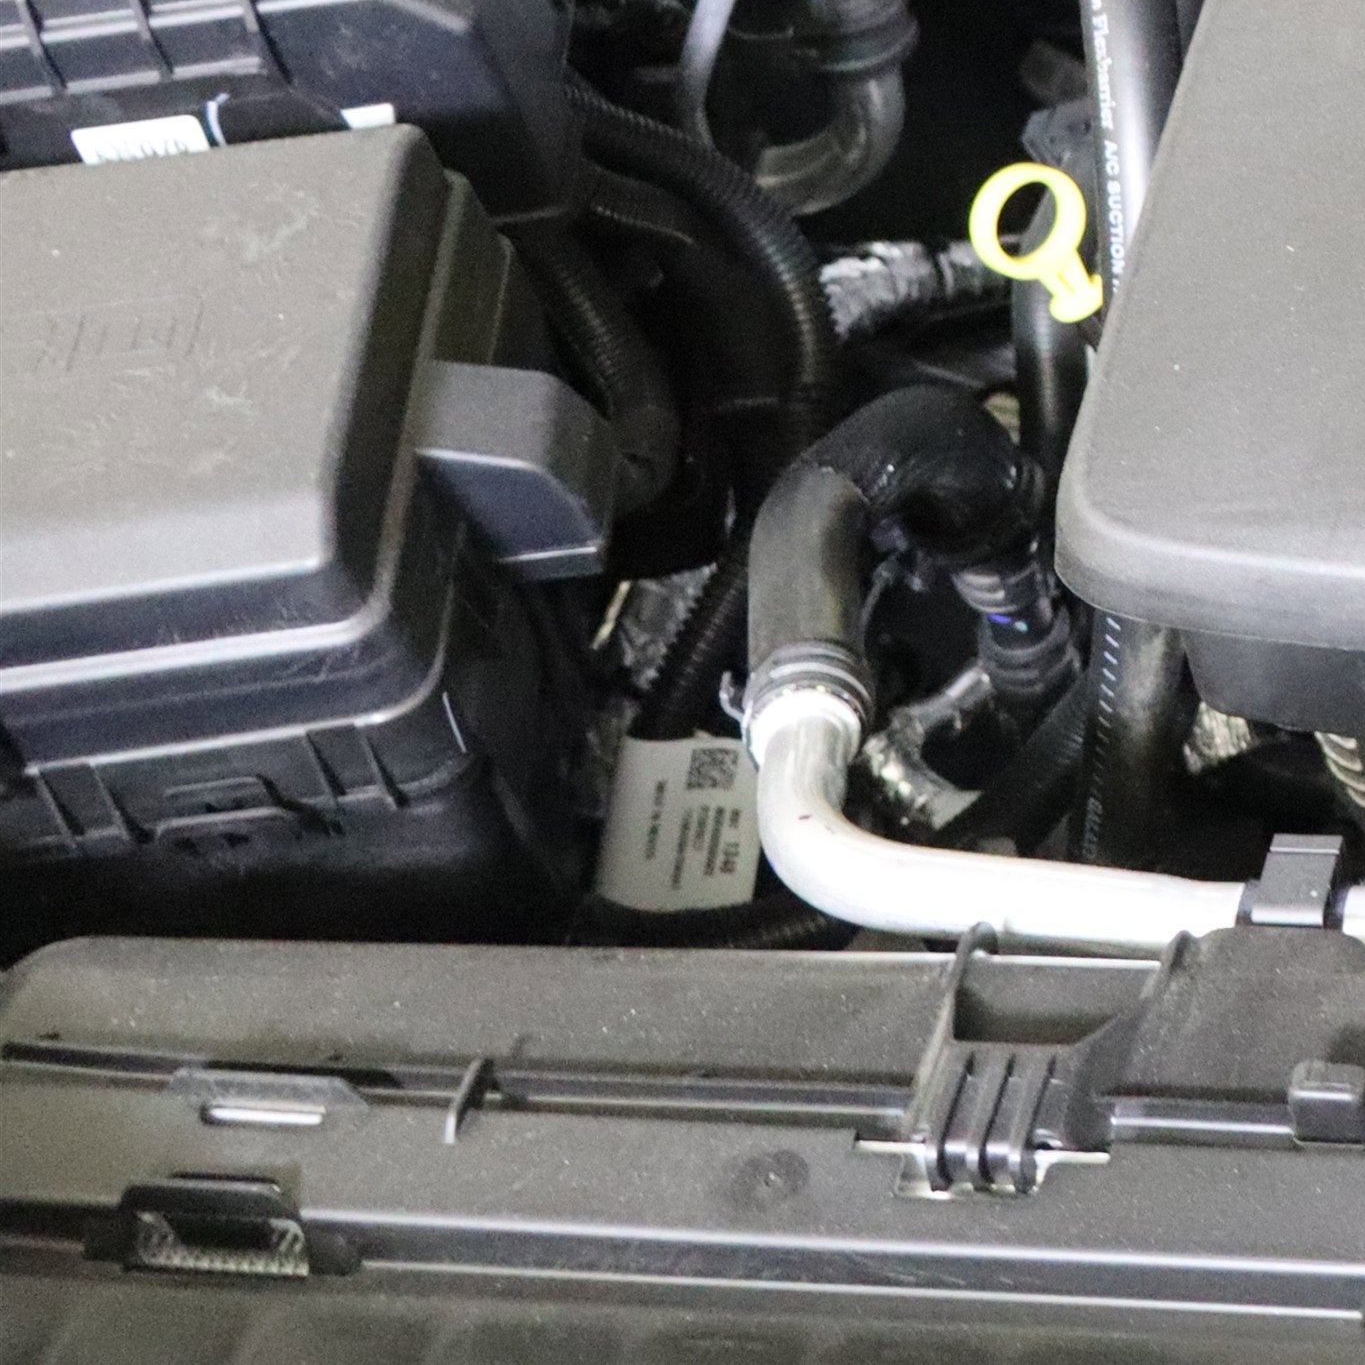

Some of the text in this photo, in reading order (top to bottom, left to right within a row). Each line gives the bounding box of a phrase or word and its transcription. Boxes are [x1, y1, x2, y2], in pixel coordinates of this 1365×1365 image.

[1092, 13, 1115, 129] Flexbarrier
[1103, 139, 1119, 176] A/C
[1106, 181, 1124, 273] SUCTION
